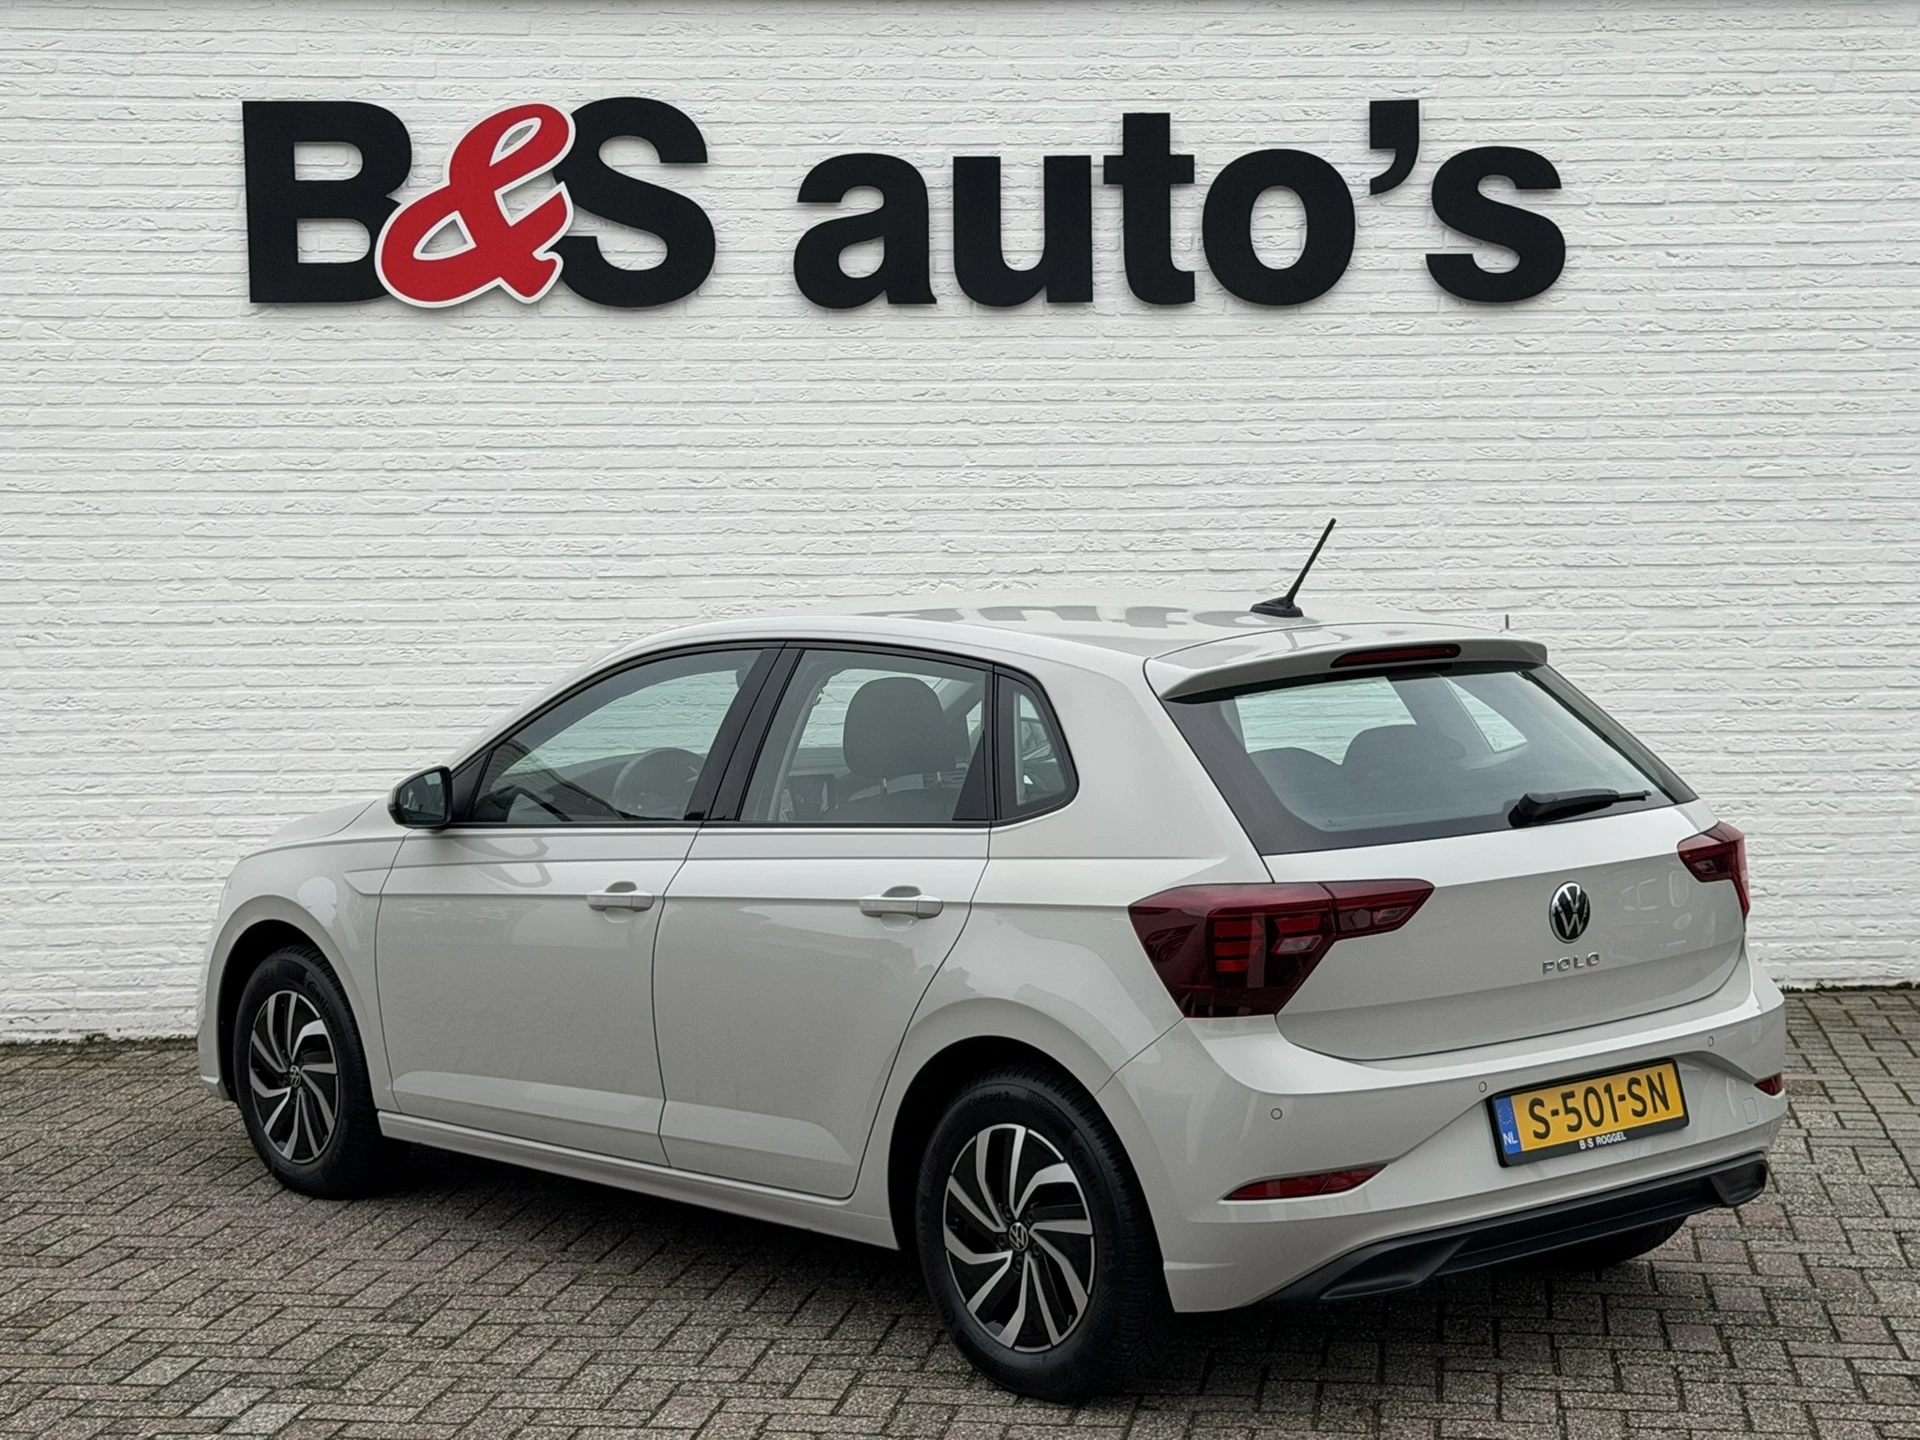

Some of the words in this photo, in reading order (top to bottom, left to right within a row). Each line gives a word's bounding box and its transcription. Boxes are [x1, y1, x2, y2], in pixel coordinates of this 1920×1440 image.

[242, 97, 716, 308] B&S
[1549, 881, 1590, 943] VW
[1542, 951, 1600, 975] POLO
[1528, 1071, 1671, 1140] S-501-SN
[1503, 1131, 1518, 1145] NL
[1595, 1131, 1627, 1146] ROGGEL
